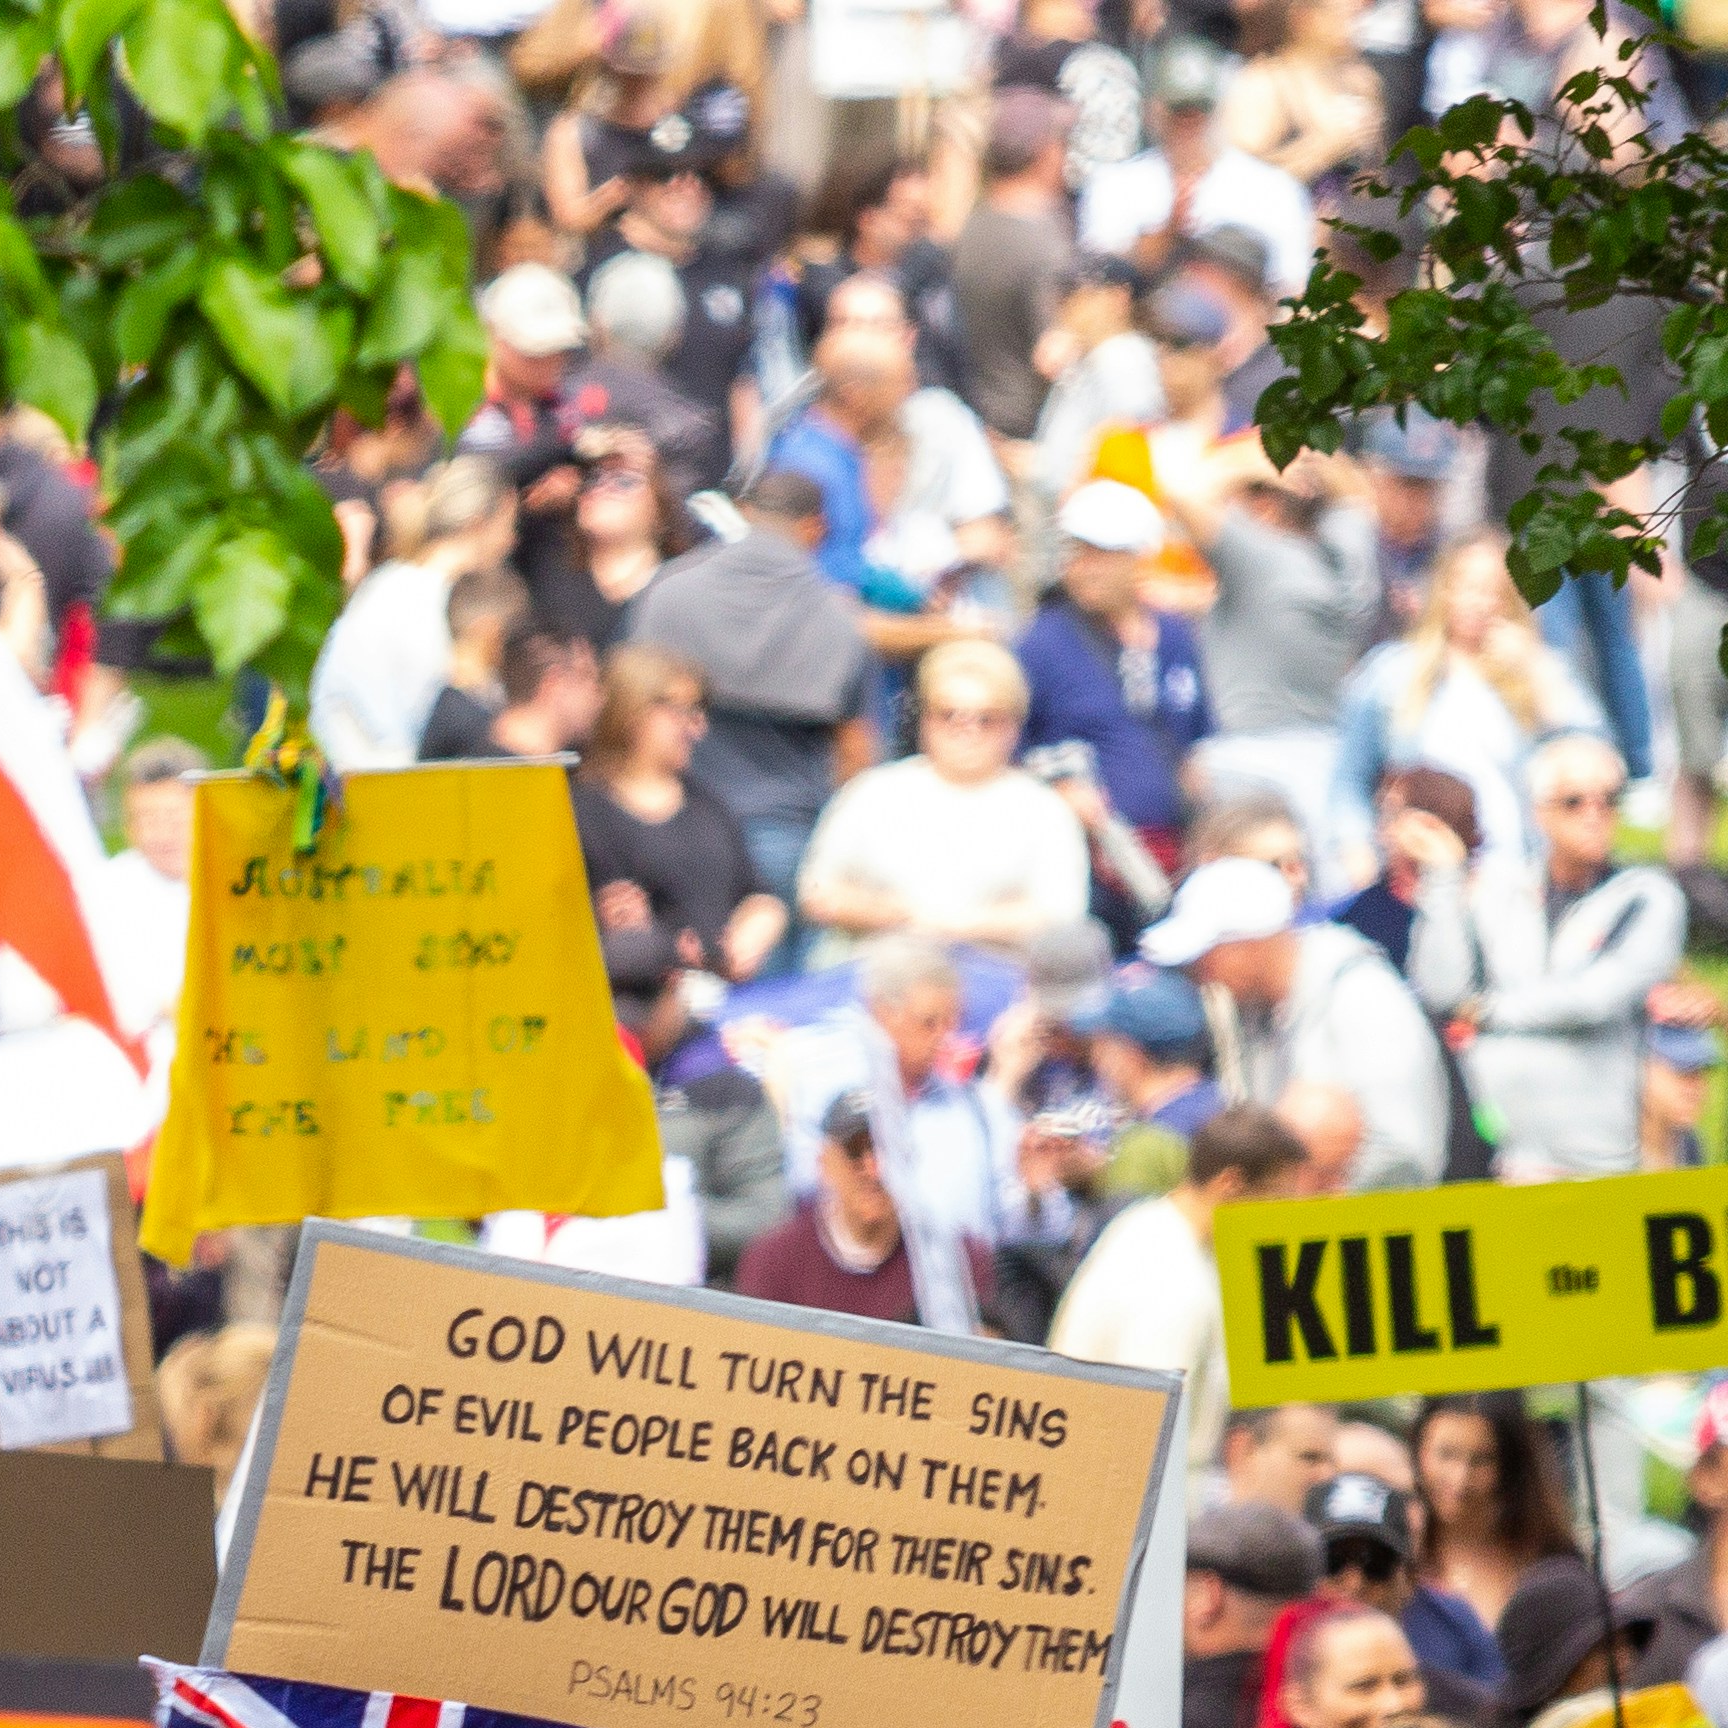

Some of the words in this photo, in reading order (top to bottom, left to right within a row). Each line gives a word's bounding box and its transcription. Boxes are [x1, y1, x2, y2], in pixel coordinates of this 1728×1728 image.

[14, 1259, 71, 1293] NOT
[87, 1302, 107, 1334] A
[1254, 1227, 1502, 1365] KILL
[1546, 1262, 1601, 1298] the
[1643, 1205, 1728, 1334] B
[380, 1383, 445, 1426] OF
[454, 1394, 543, 1443] EVIL
[556, 1405, 715, 1463] PEOPLE
[728, 1426, 838, 1482] BACK
[847, 1448, 908, 1492] ON
[446, 1308, 566, 1365] GOD
[587, 1329, 697, 1390] WILL
[719, 1350, 847, 1408] TURN
[858, 1372, 936, 1421] THE
[969, 1391, 1069, 1449] SINS
[303, 1452, 379, 1503] HE
[390, 1459, 497, 1525] WILL
[514, 1480, 696, 1549] DESTROY
[704, 1504, 806, 1562] THEM
[807, 1520, 881, 1574] FOR
[891, 1533, 993, 1587] THEIR
[998, 1548, 1097, 1598] SINS.
[340, 1538, 423, 1592] THE
[438, 1544, 566, 1623] LORD
[570, 1571, 653, 1626] OUR
[657, 1576, 749, 1639] GOD
[761, 1594, 849, 1646] WILL
[858, 1604, 1021, 1670] DESTROY
[1023, 1623, 1114, 1678] THEM
[569, 1659, 698, 1712] PSALMS
